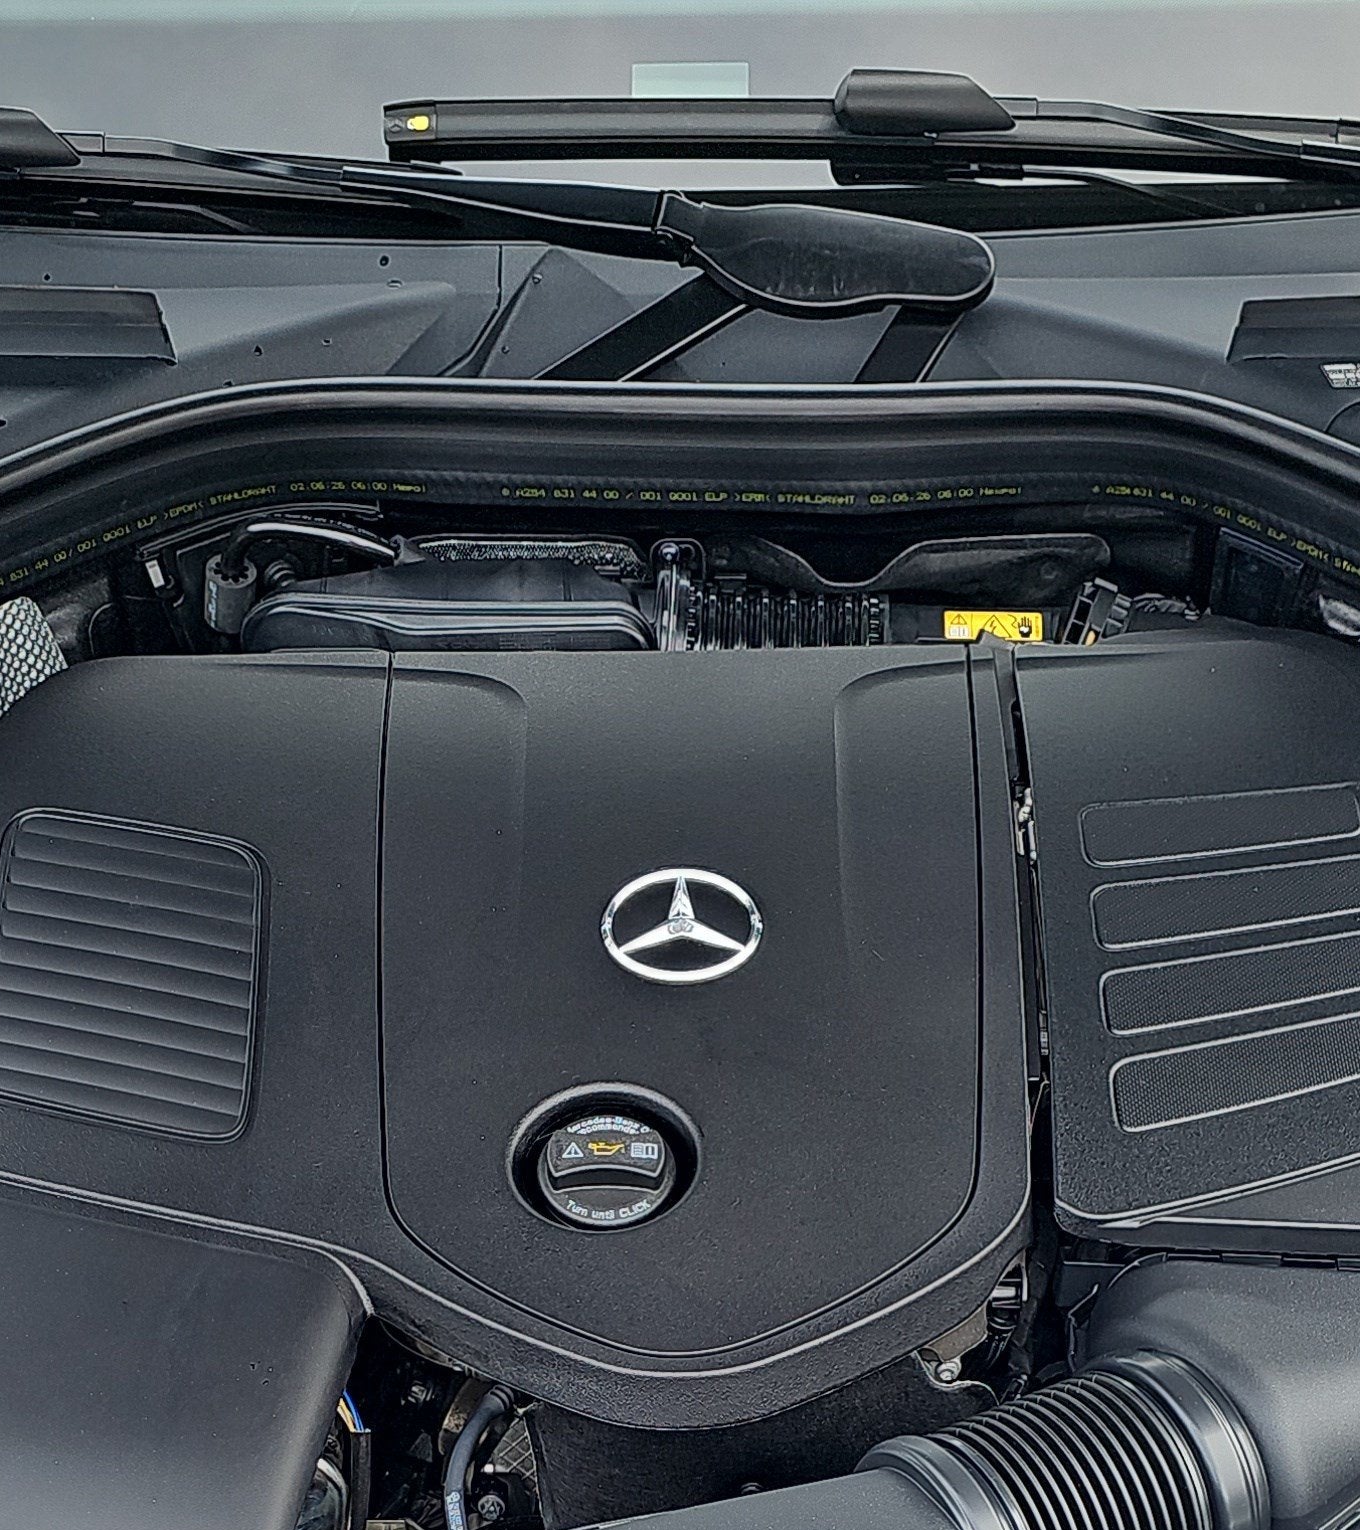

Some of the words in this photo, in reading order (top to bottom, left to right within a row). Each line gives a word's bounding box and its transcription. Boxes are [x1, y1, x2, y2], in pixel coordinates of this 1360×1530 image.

[566, 1200, 589, 1217] Turn
[592, 1209, 615, 1219] until
[619, 1199, 651, 1218] CLICK
